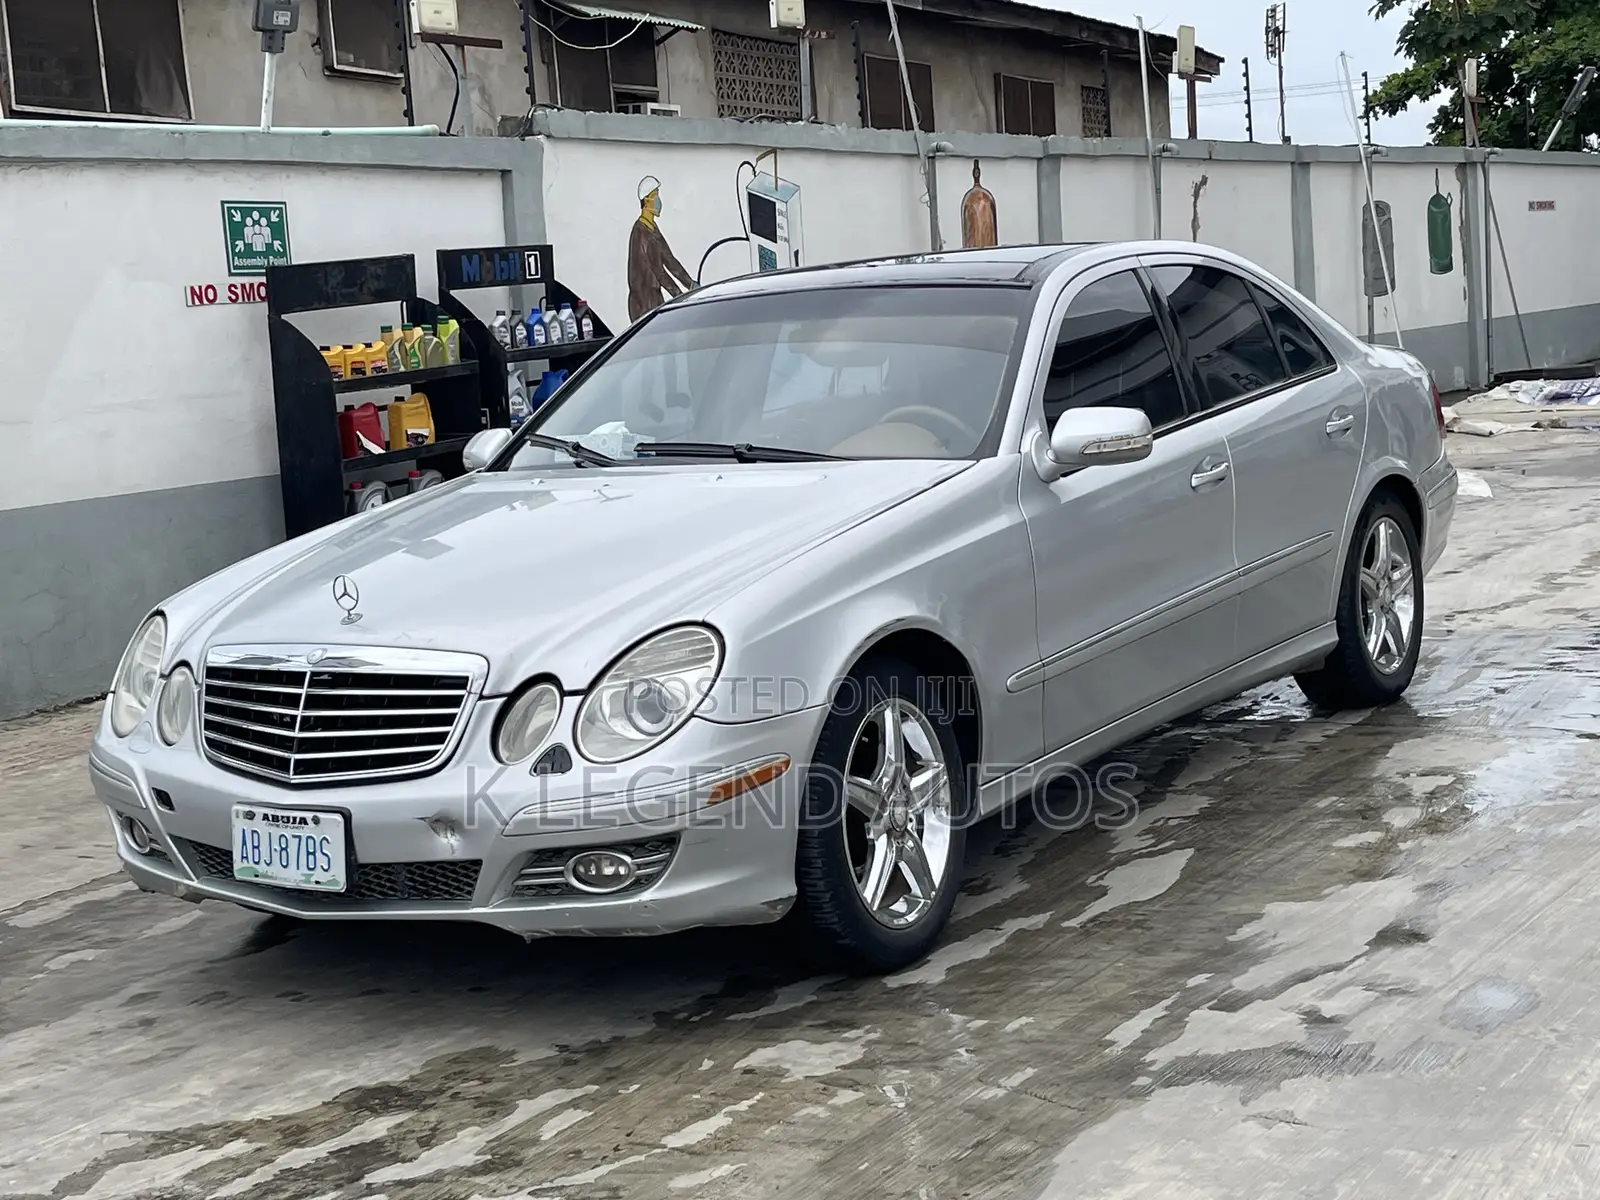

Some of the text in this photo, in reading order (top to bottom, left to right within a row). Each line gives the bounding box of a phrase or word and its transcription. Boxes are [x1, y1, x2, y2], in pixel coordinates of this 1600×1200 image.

[234, 256, 287, 267] Assembly Point
[190, 282, 268, 305] NO SMO
[261, 812, 309, 826] ABUJA
[240, 828, 332, 873] ABJ-87BS
